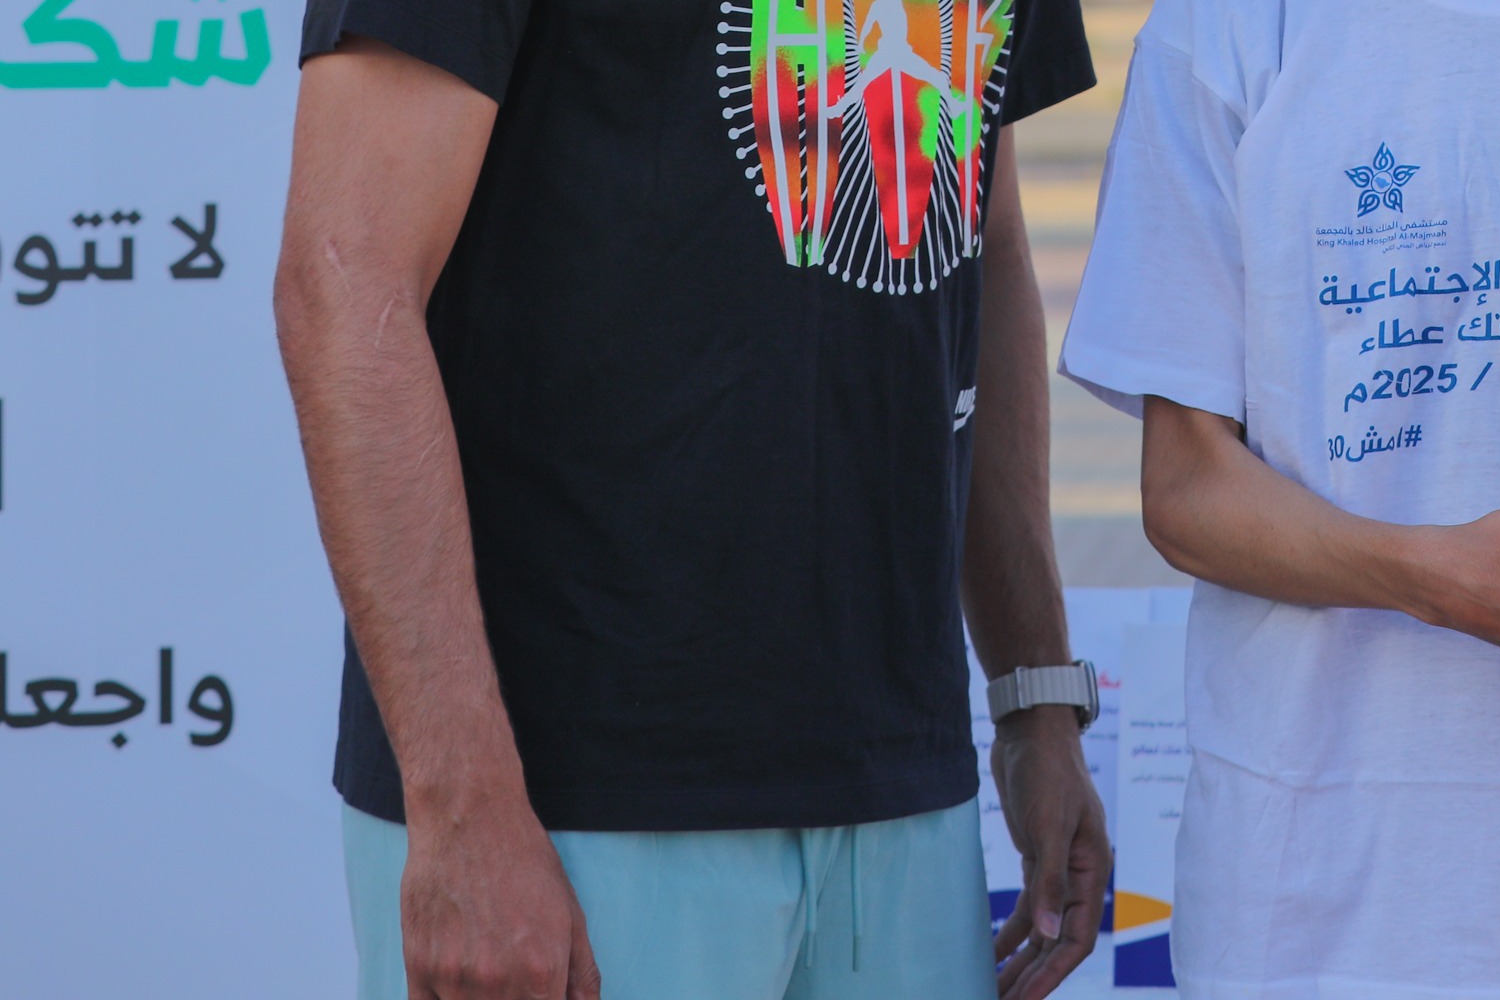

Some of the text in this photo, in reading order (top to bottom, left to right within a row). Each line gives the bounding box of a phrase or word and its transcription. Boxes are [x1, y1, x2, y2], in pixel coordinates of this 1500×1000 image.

[1315, 226, 1353, 236] بالمجمعة
[1356, 225, 1373, 235] خالد
[1317, 239, 1335, 248] King
[1337, 238, 1364, 247] Khaled
[1367, 234, 1397, 245] Hospital
[0, 203, 224, 305] لا تتو
[1359, 318, 1444, 356] عطاء
